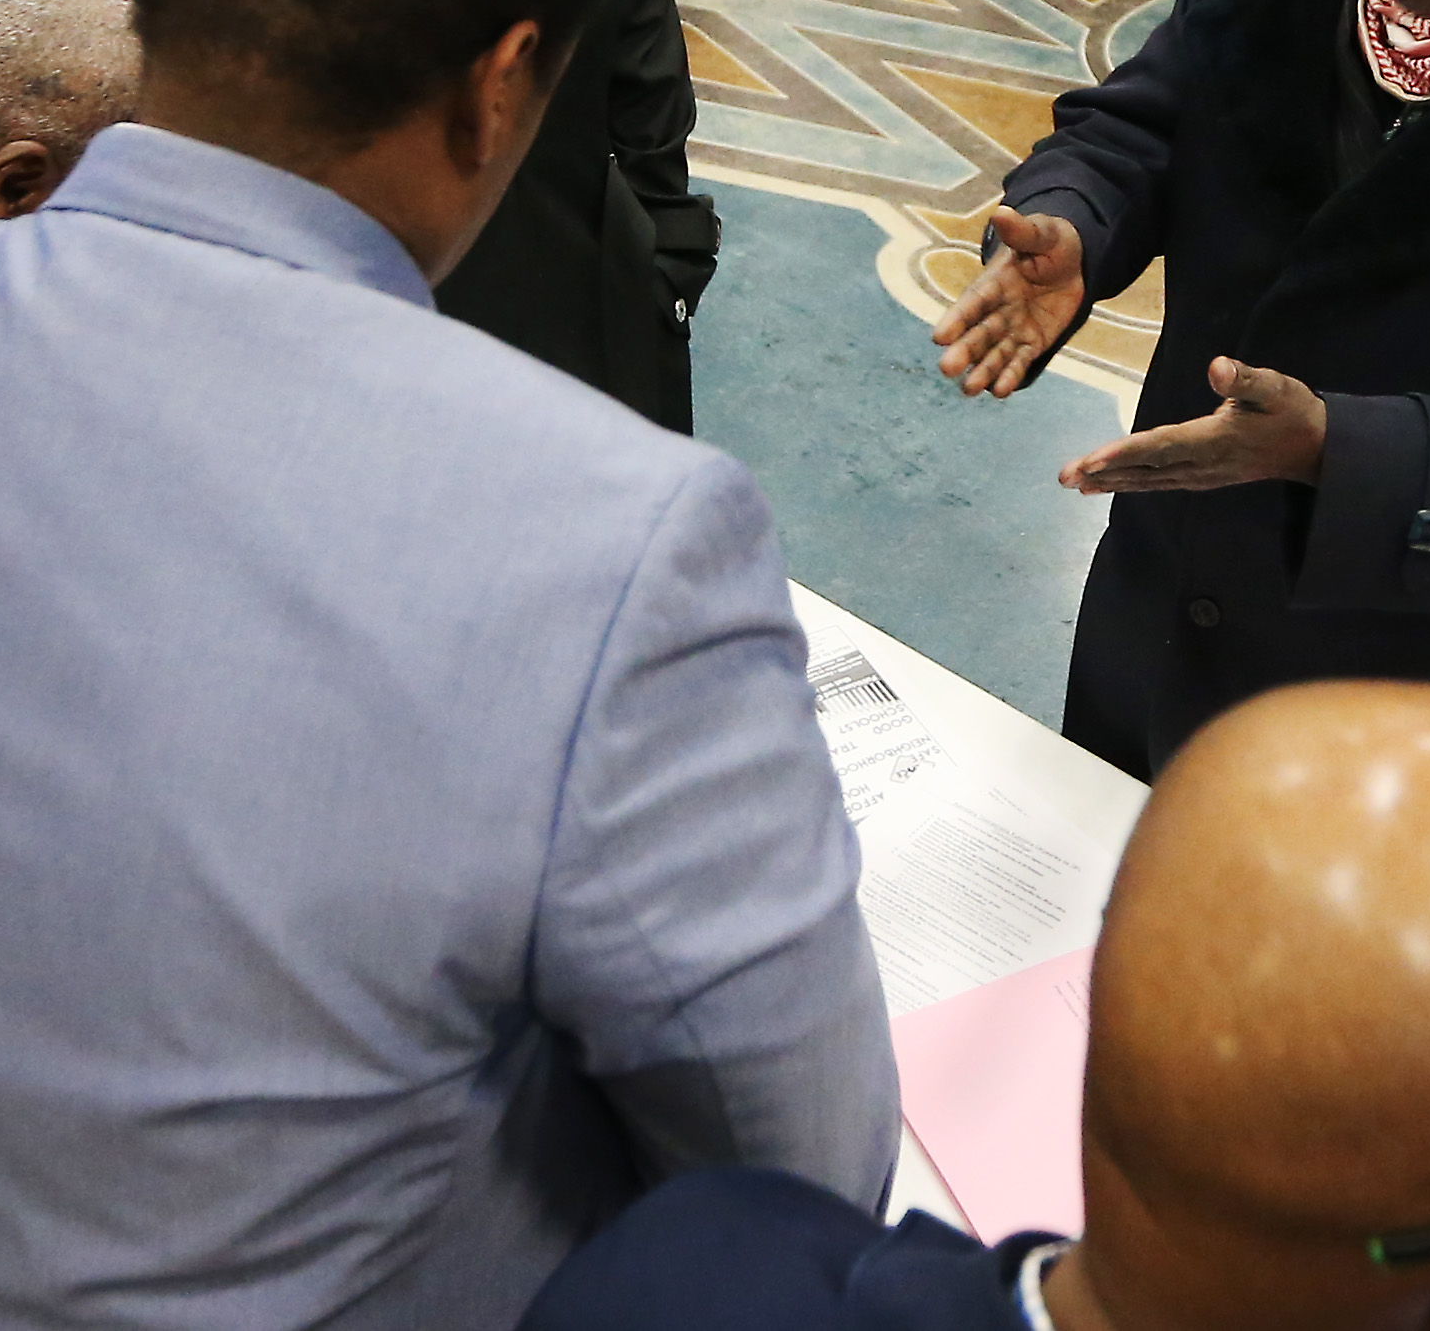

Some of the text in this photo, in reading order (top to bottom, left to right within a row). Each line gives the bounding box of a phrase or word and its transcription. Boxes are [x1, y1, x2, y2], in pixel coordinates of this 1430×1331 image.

[872, 715, 913, 735] GOOD
[828, 741, 858, 756] TRA
[836, 734, 931, 776] NEIGHBORHOO
[842, 783, 870, 799] HOU
[845, 792, 884, 815] AFFOR
